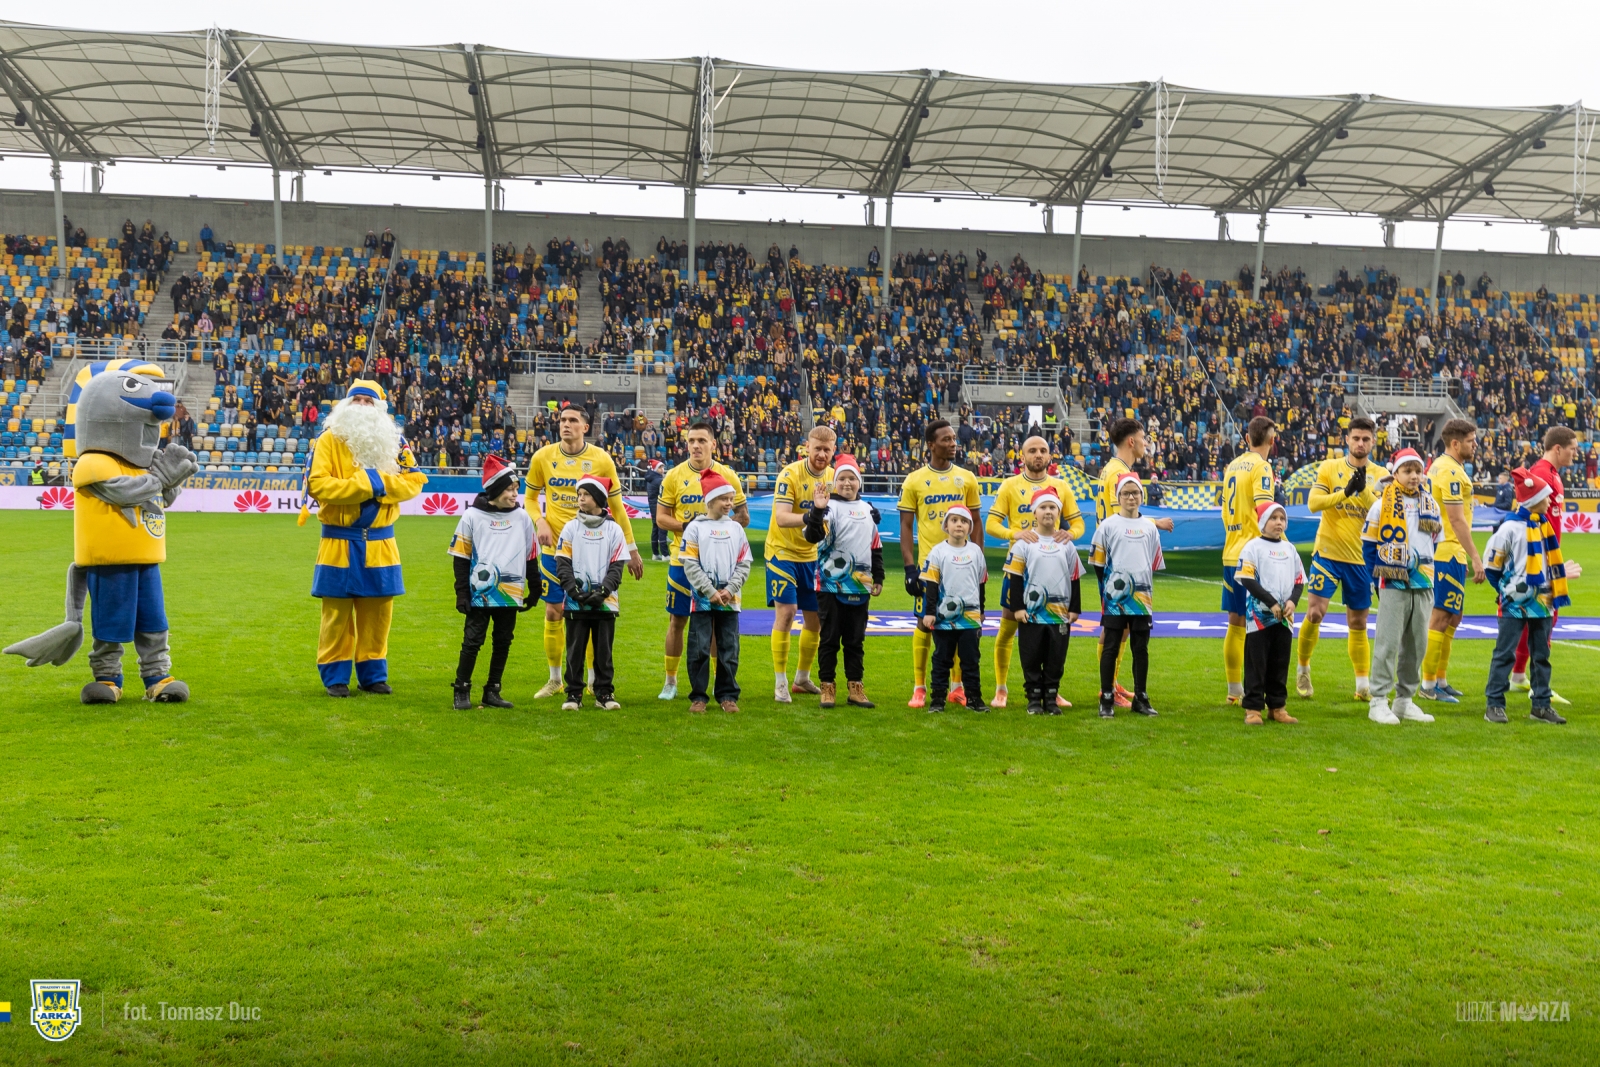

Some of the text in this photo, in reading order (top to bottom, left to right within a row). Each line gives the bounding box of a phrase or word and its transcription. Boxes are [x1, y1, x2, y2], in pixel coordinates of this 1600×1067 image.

[545, 373, 555, 385] G
[617, 375, 631, 387] 15
[971, 386, 980, 396] H
[1037, 388, 1050, 399] 16
[1428, 398, 1440, 409] 17
[262, 478, 298, 491] ARKA
[1228, 476, 1236, 515] 2
[771, 579, 788, 597] 37
[1308, 573, 1325, 591] 23
[1443, 591, 1463, 611] 29
